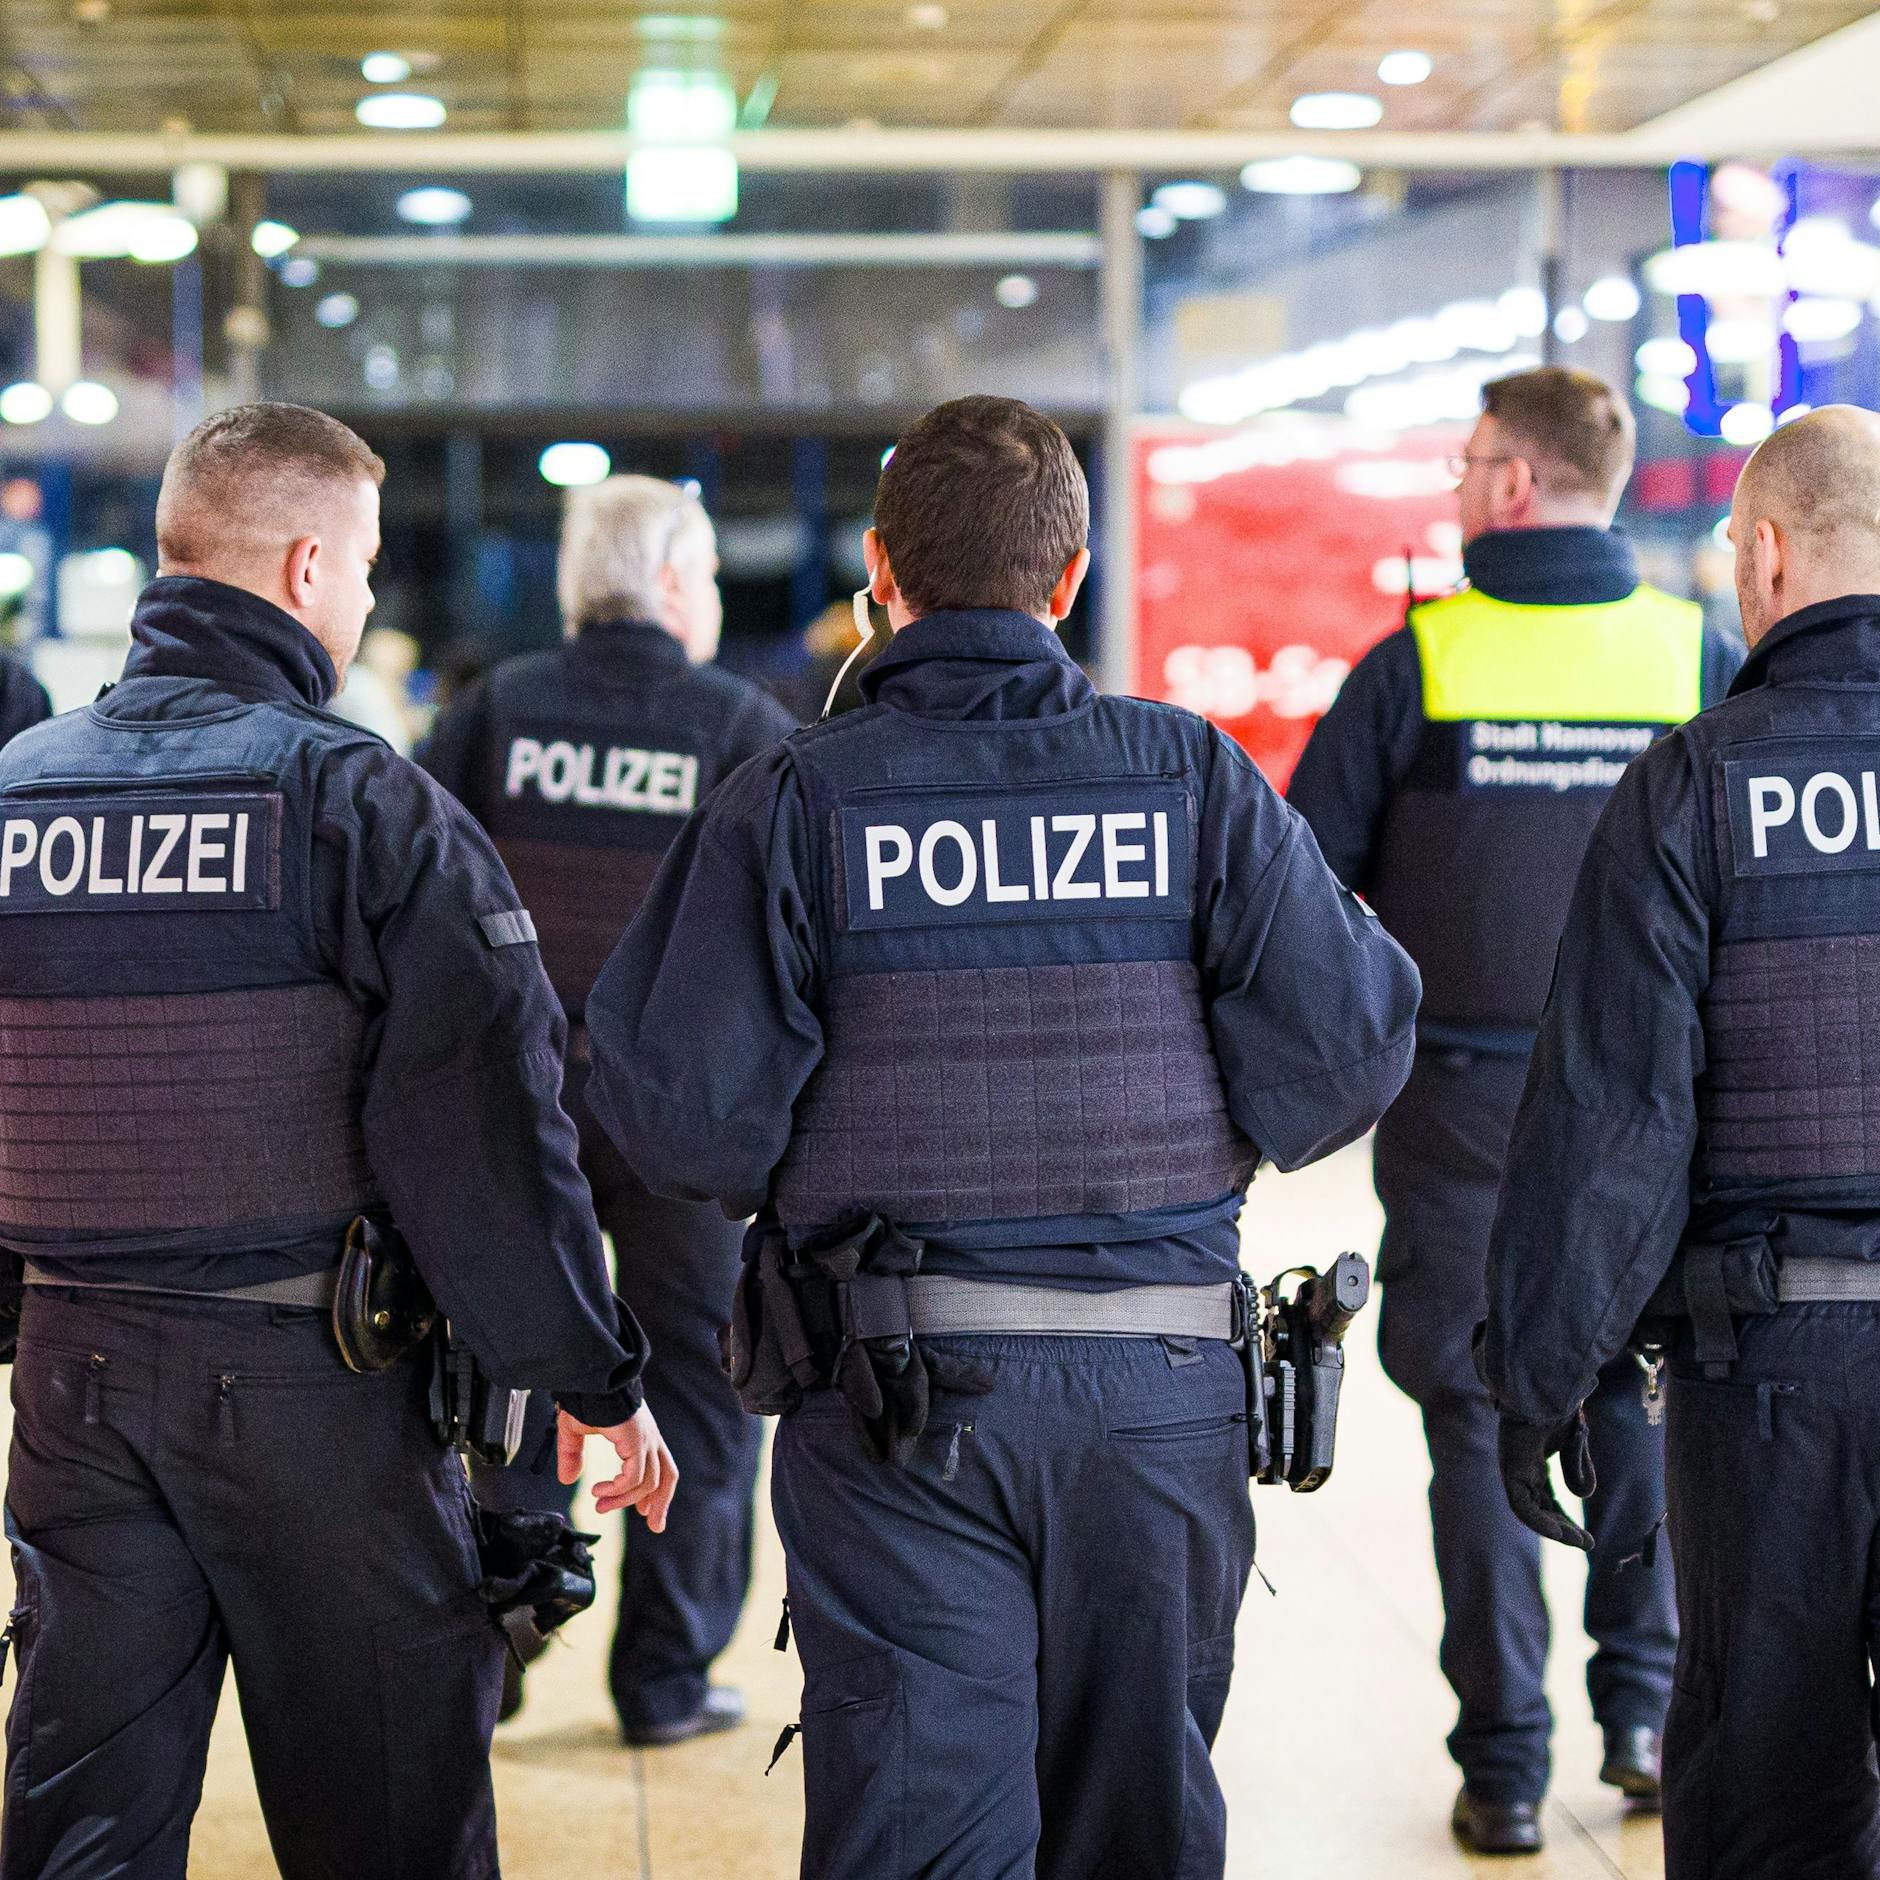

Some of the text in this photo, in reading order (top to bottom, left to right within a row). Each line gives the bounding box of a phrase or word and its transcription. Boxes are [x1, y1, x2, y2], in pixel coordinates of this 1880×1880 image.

[1472, 721, 1536, 749] Stadt
[506, 737, 697, 816] POLIZEI
[0, 813, 249, 897] POLIZEI
[865, 812, 1169, 910] POLIZEI
